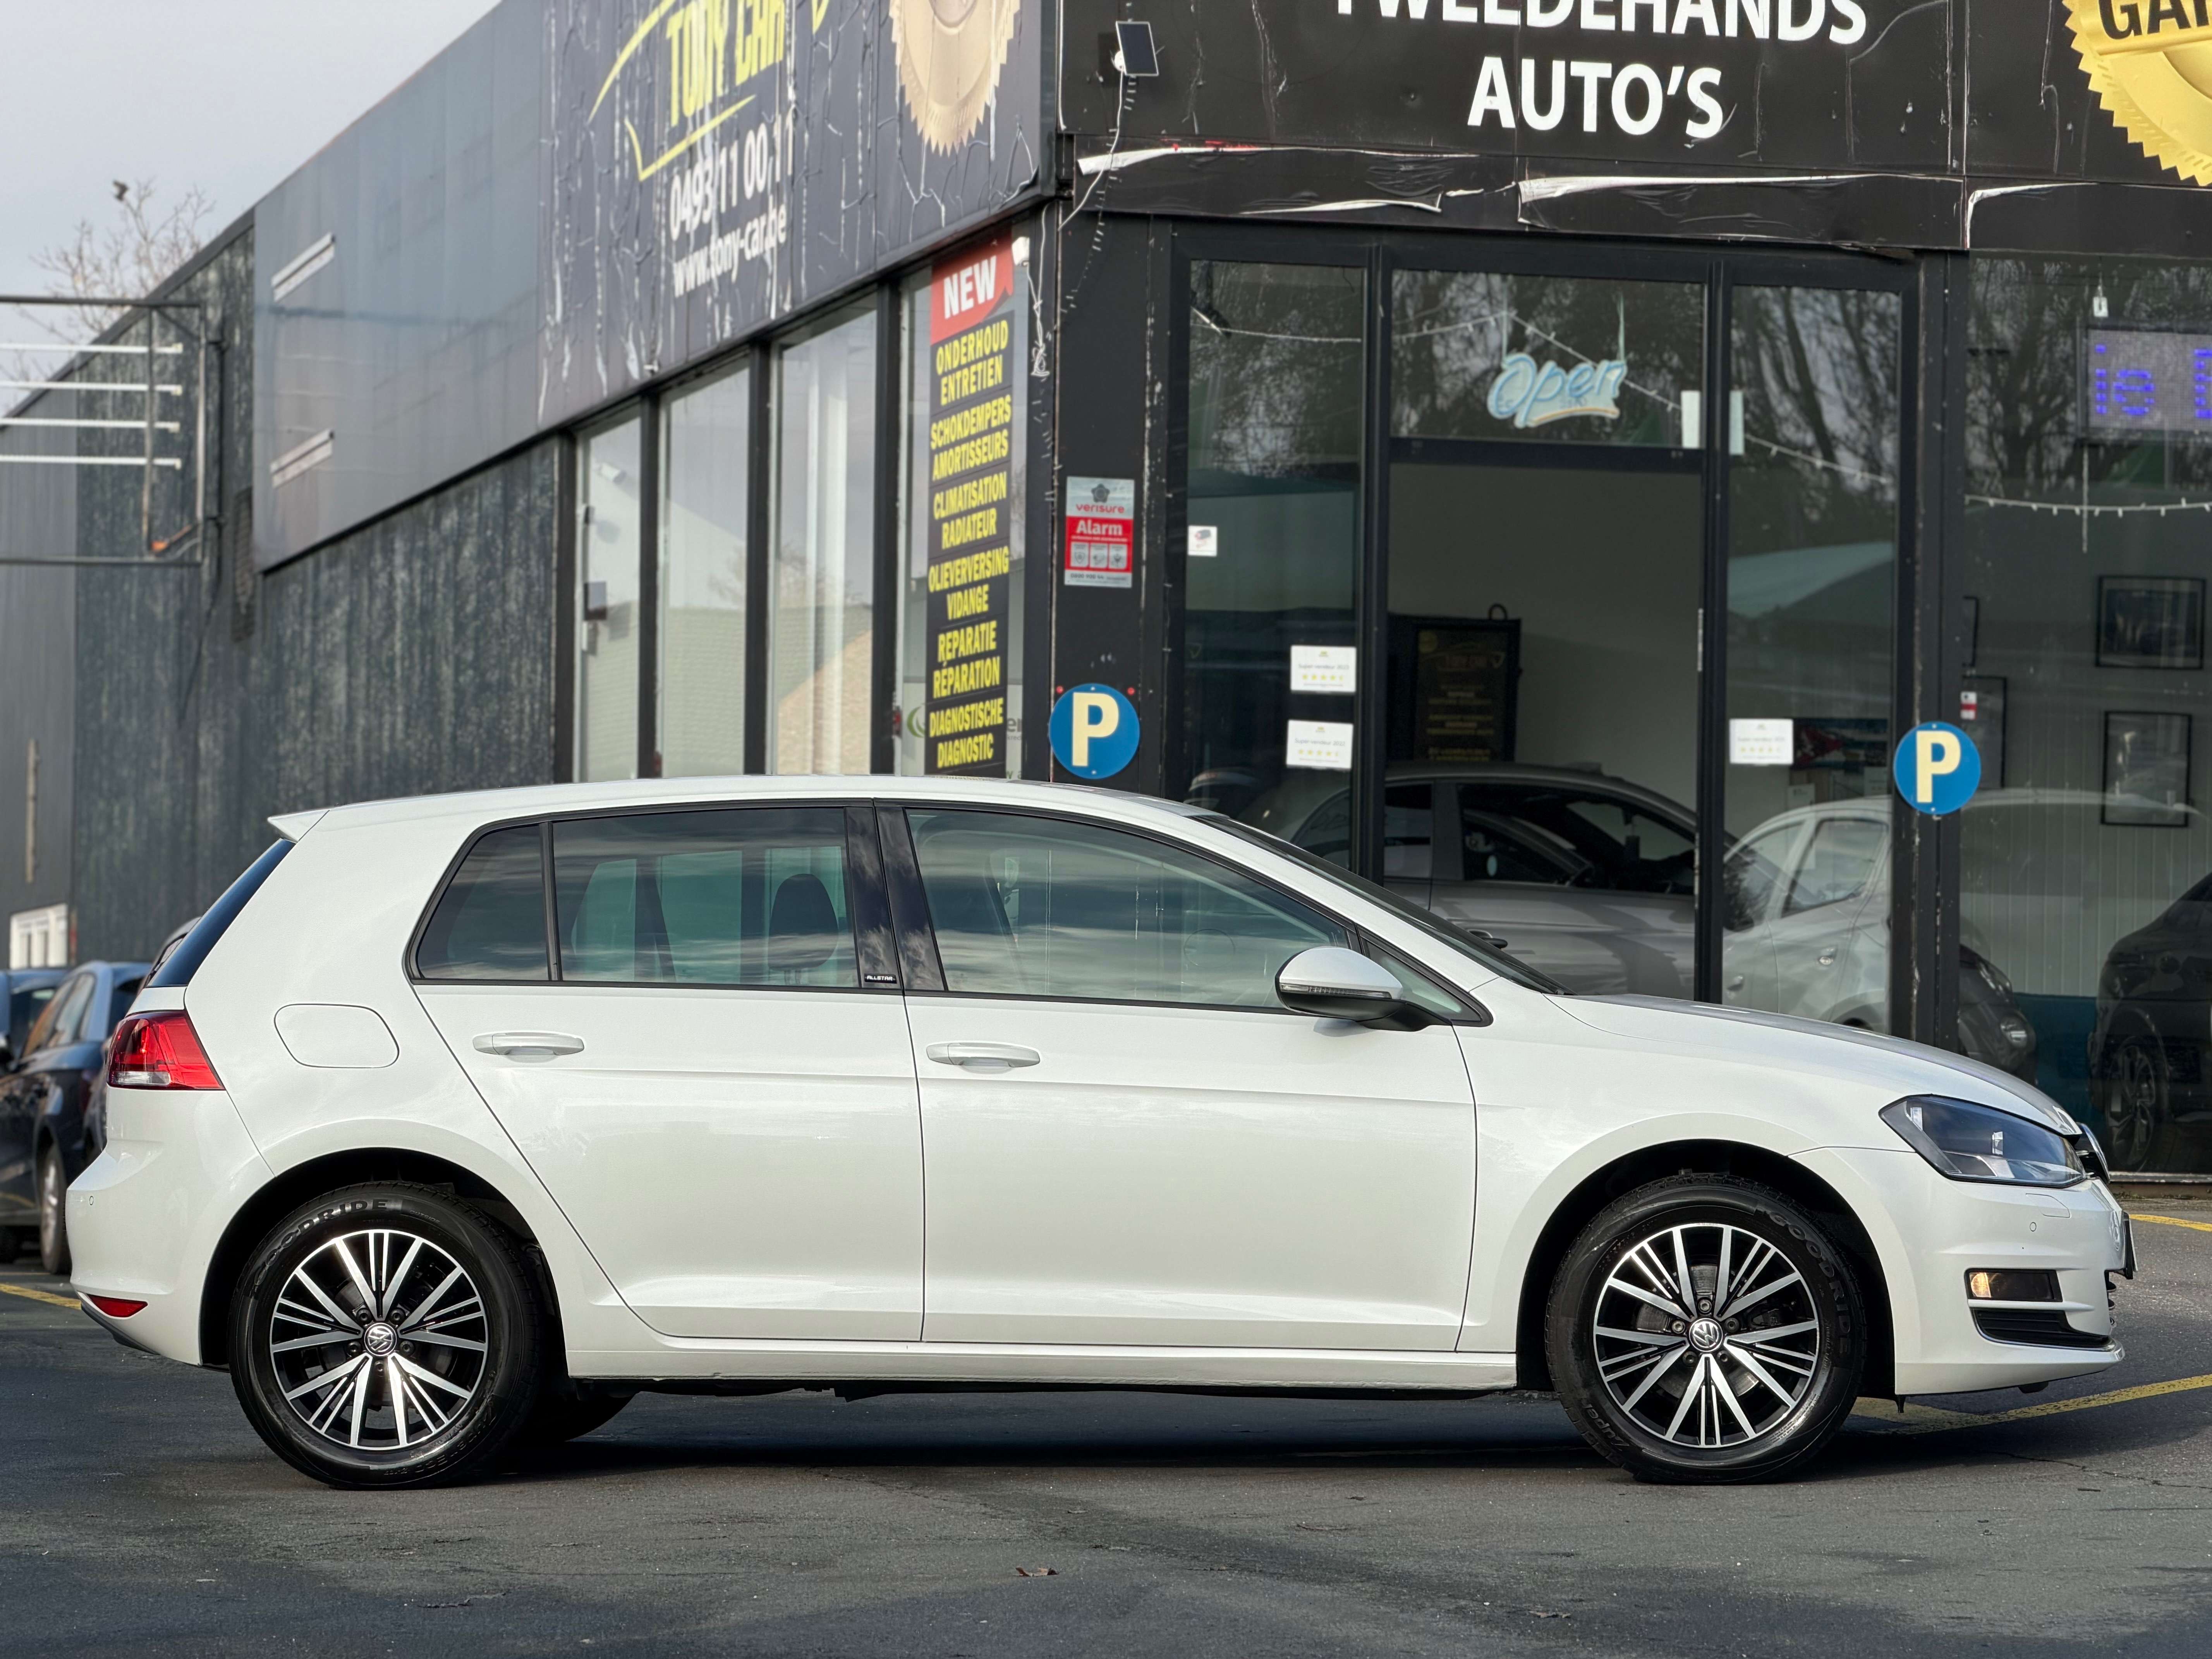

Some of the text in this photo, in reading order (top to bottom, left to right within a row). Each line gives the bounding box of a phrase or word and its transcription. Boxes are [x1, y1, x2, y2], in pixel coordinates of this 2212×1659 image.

[1468, 57, 1723, 139] AUTO'S
[744, 123, 768, 200] 00
[944, 256, 997, 319] NEW
[936, 320, 1008, 376] ONDERHOUD
[941, 354, 1003, 405] ENTRETIEN
[1488, 353, 1627, 428] Open
[931, 395, 1011, 449] SCHOKDEMPERS
[933, 429, 1008, 481] AMORTISSEURS
[934, 471, 1007, 520] CLIMATISATION
[1076, 503, 1125, 514] verisure
[942, 508, 997, 550] RADIATEUR
[1077, 520, 1122, 536] Alarm
[929, 546, 1009, 593] OLIEVERVERSING
[947, 584, 989, 620] VIDANGE
[938, 620, 997, 662] REPARATIE
[933, 656, 1000, 699] RÉPARATION
[929, 697, 1004, 738] DIAGNOSTISCHE
[1072, 692, 1119, 766] P
[937, 733, 994, 768] DIAGNOSTIC
[1916, 730, 1961, 803] P
[1769, 1211, 1851, 1355] GOODRIDE
